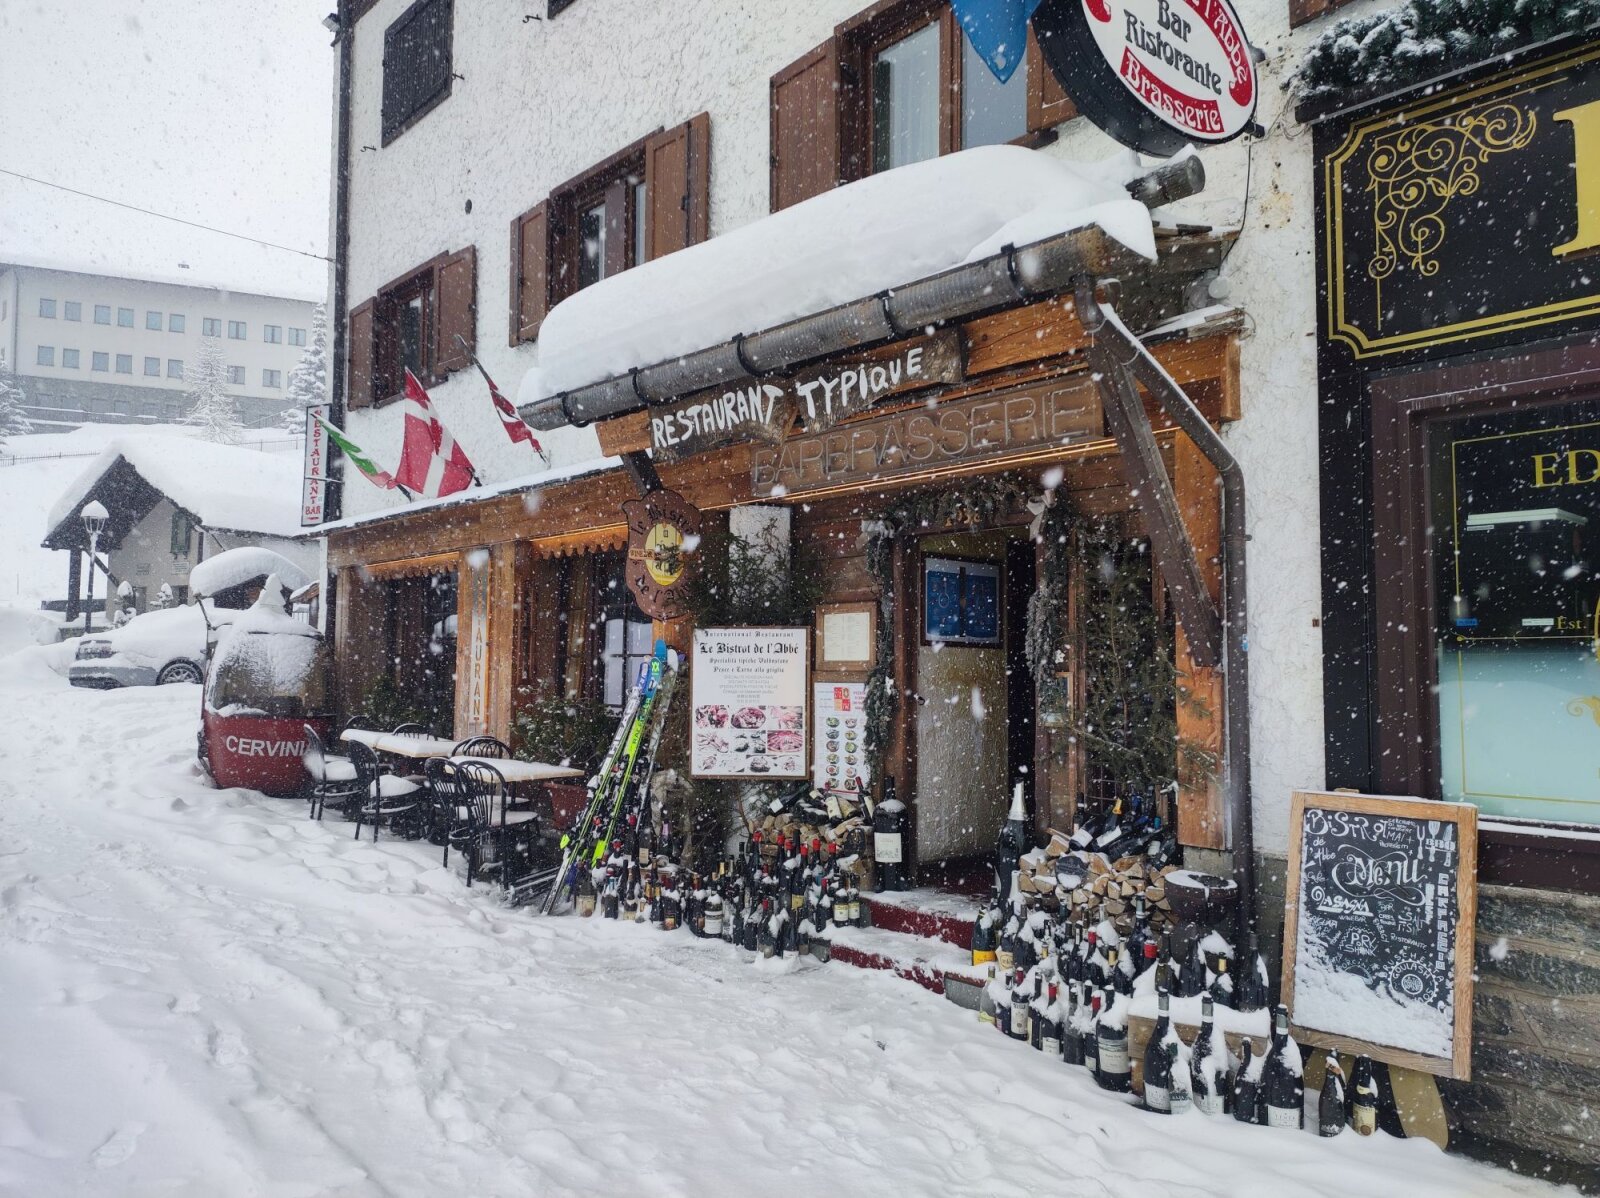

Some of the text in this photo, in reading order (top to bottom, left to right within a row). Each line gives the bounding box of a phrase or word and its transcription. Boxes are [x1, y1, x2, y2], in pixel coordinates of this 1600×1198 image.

[1157, 0, 1191, 43] Bar
[1123, 8, 1222, 96] Ristorante
[1125, 50, 1221, 132] Brasserie
[652, 383, 785, 449] RESTAURANT
[305, 505, 321, 516] BAR
[704, 630, 794, 638] International Restaurant
[1556, 615, 1587, 631] Est.
[700, 642, 799, 654] Le Bistrot de l'Abbé
[226, 735, 309, 757] CERVINI
[1381, 951, 1445, 983] RUSCHETTA
[1393, 962, 1431, 980] GOULASH
